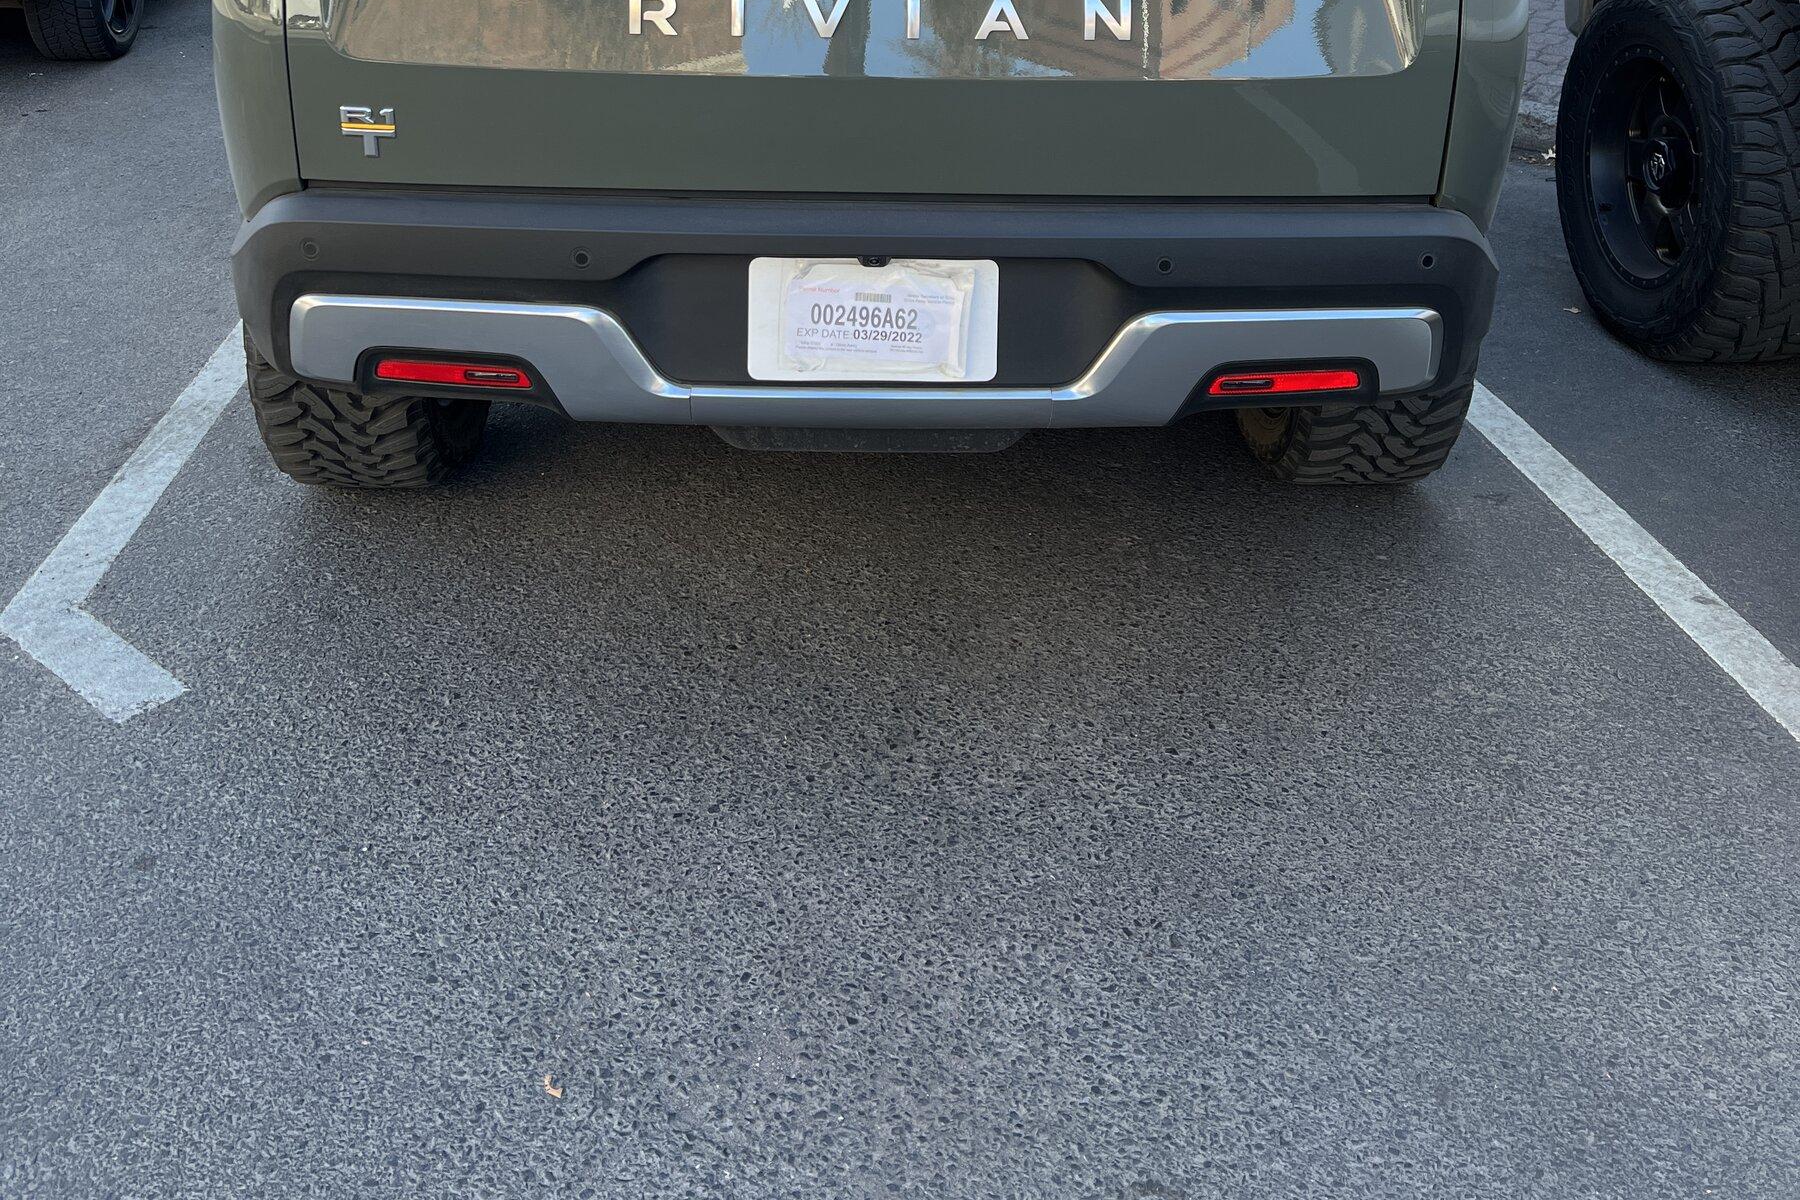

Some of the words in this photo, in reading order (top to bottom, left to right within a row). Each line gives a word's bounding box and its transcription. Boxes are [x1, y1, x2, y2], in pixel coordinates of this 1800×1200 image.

[810, 303, 918, 330] 002496A62
[797, 328, 818, 337] EXP
[853, 329, 922, 344] 03/29/2022
